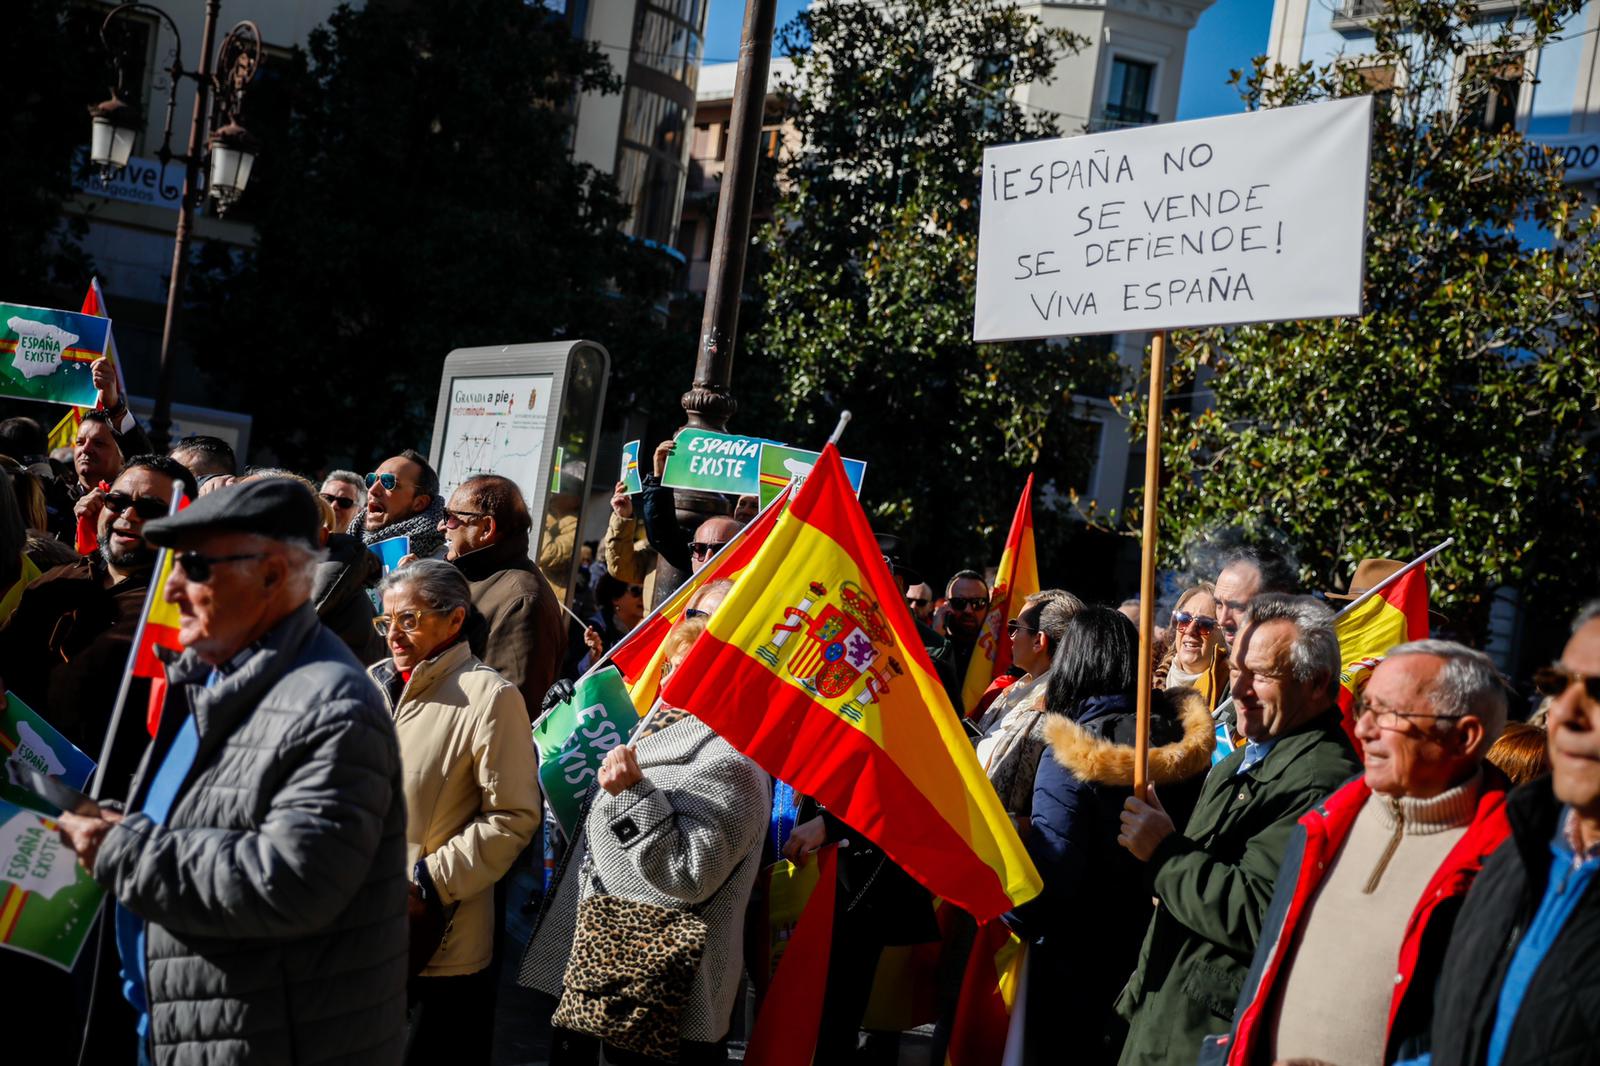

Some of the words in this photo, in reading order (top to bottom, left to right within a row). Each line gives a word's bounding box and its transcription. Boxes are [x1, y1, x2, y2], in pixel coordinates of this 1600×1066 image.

[1163, 143, 1214, 176] NO
[1073, 201, 1126, 237] SE
[1143, 184, 1271, 224] VENDE
[1014, 251, 1061, 281] SE
[1030, 290, 1098, 321] VIVA
[1122, 268, 1254, 312] ESPAÑA
[21, 335, 61, 353] ESPAÑA
[24, 350, 57, 364] EXISTE
[487, 393, 494, 403] a
[494, 390, 509, 406] pie
[687, 436, 760, 458] ESPAÑA
[690, 455, 746, 478] EXISTE
[18, 743, 50, 776] ESPAÑA
[6, 826, 45, 880] ESPAÑA
